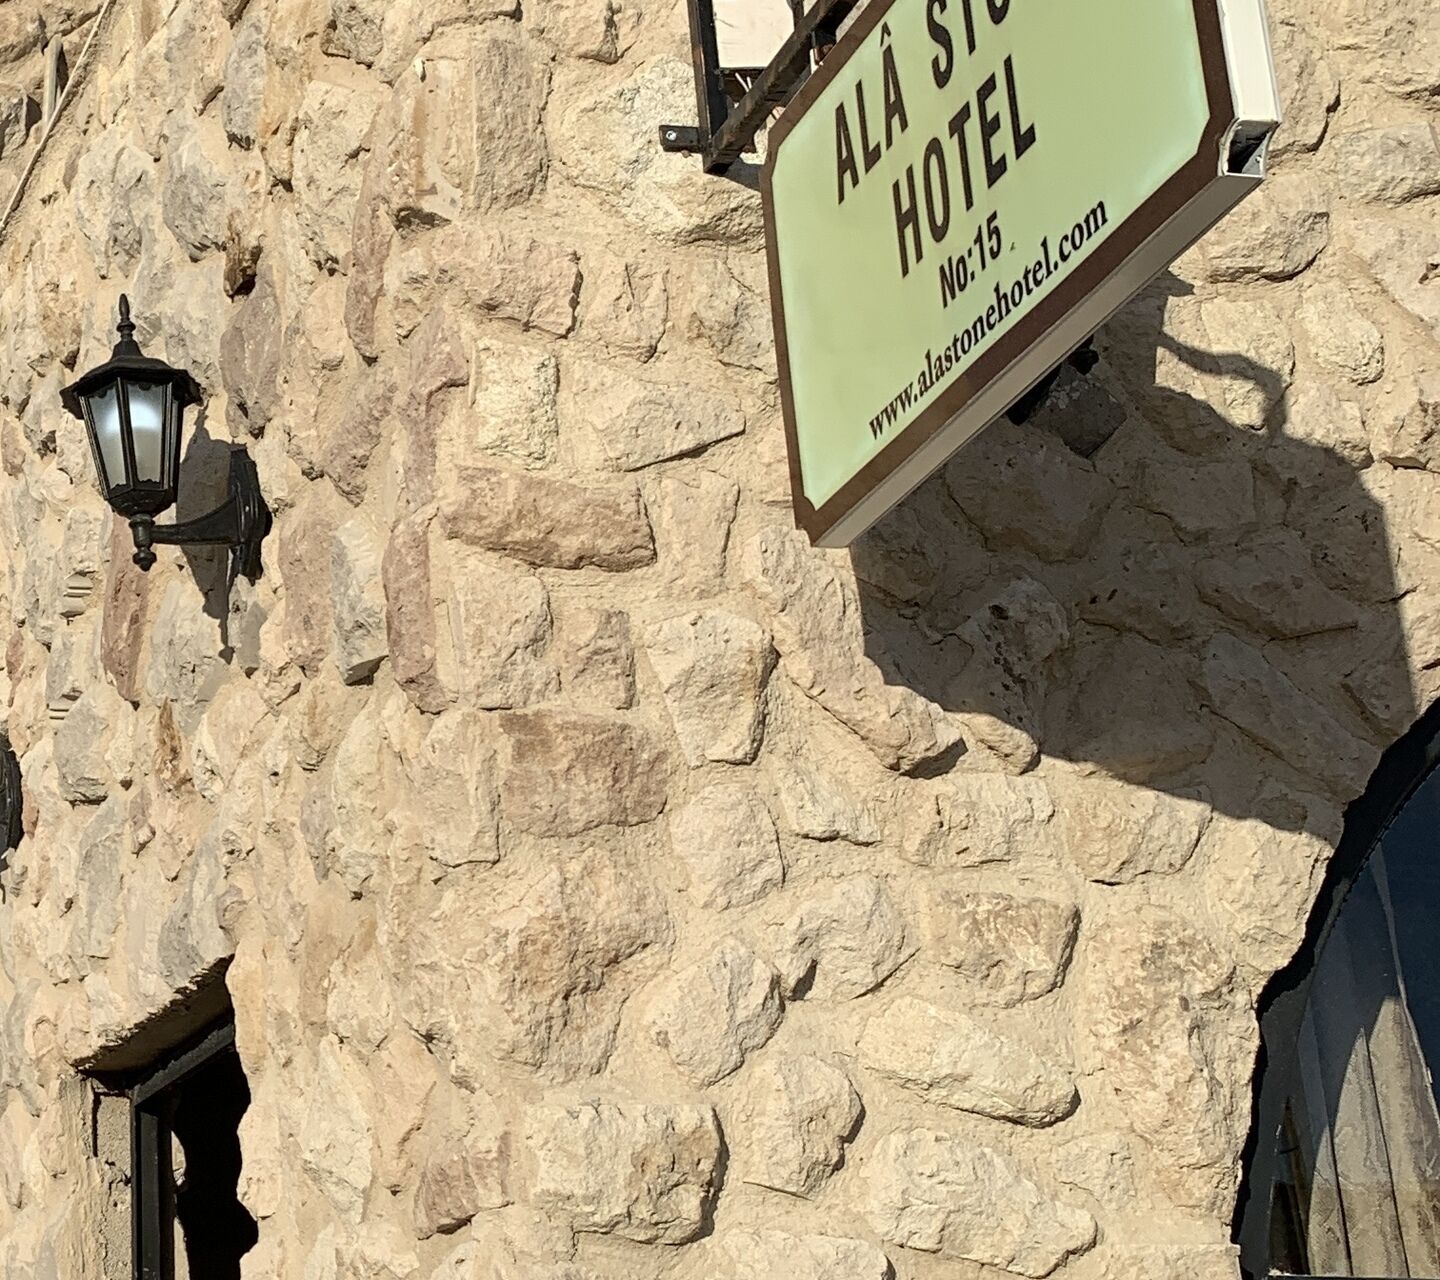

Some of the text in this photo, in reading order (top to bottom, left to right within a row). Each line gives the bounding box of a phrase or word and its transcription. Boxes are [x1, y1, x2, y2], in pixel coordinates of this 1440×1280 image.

[835, 23, 909, 204] ALÂ
[893, 54, 1037, 278] HOTEL
[869, 198, 1109, 441] www.alastonehotel.com
[939, 211, 1002, 308] No:15
